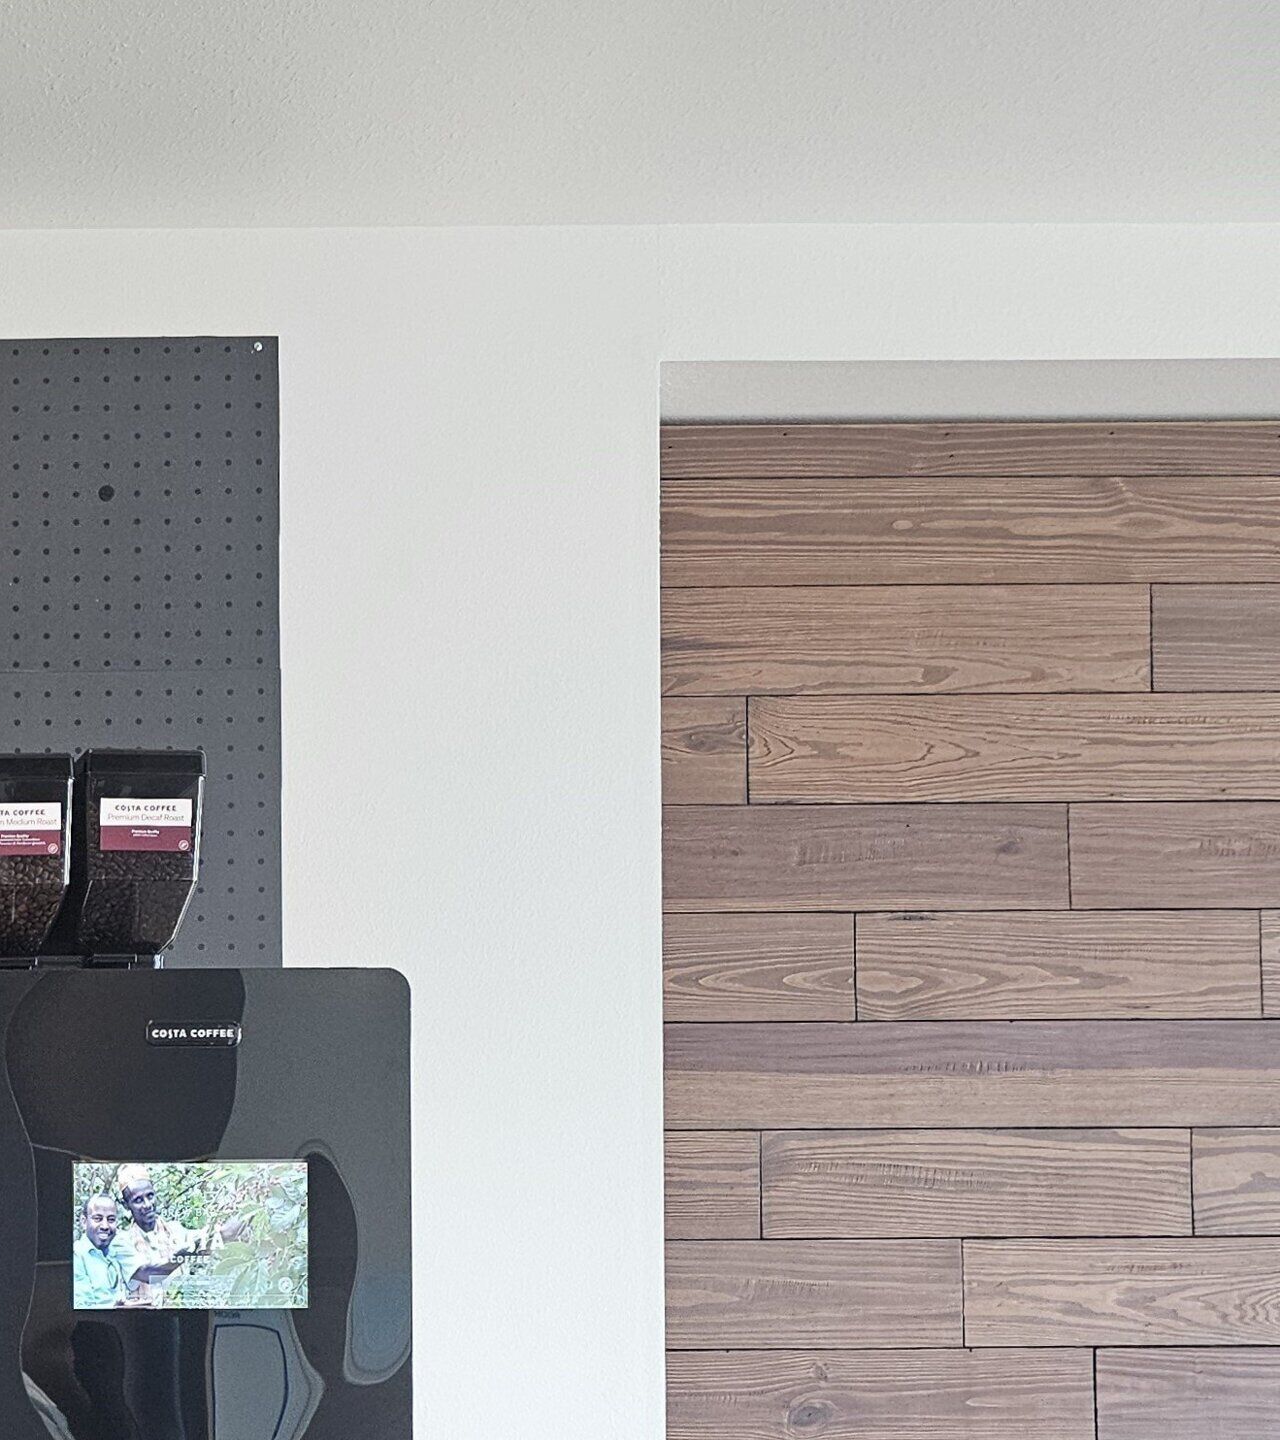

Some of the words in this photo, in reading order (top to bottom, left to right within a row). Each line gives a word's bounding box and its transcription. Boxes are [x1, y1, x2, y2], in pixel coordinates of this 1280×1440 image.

[107, 813, 140, 821] Premium
[151, 1028, 187, 1039] COSTA
[190, 1028, 234, 1038] COFFEE
